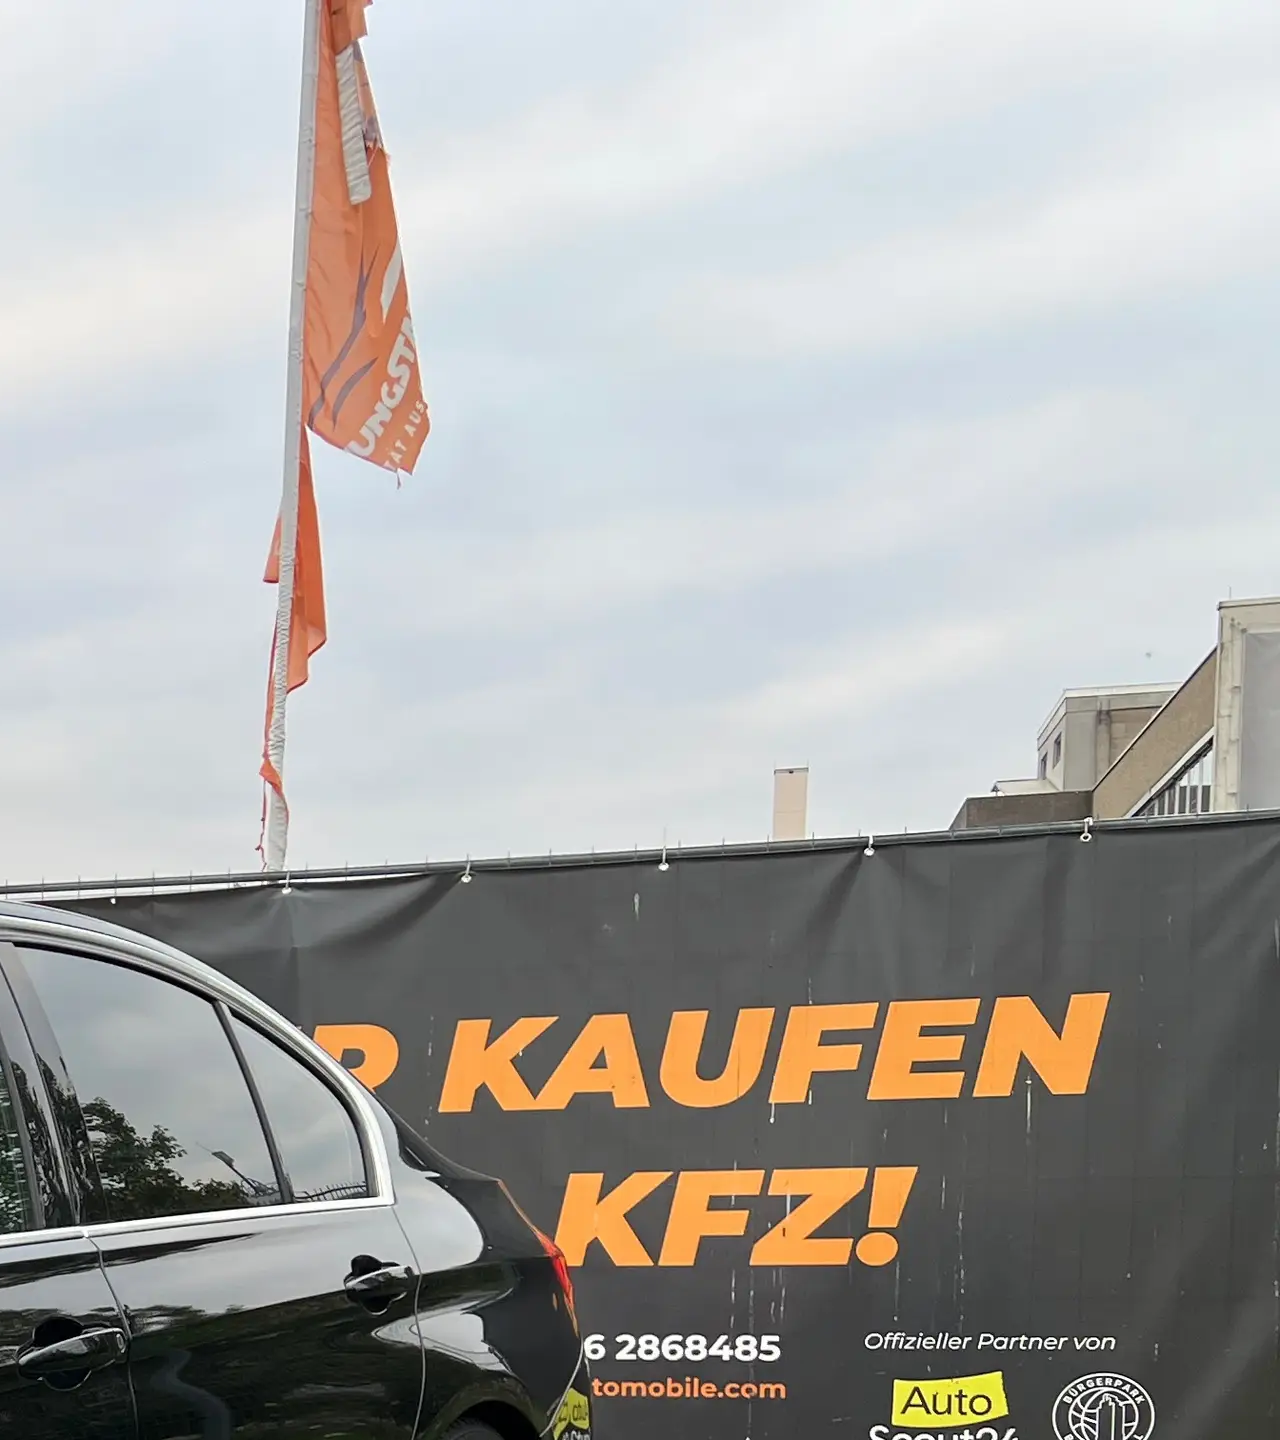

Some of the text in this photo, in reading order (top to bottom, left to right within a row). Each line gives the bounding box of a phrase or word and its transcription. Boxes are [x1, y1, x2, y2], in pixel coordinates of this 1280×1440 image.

[438, 992, 1111, 1113] KAUFEN
[554, 1166, 918, 1267] KFZ!
[615, 1333, 781, 1362] 2868485
[864, 1331, 1117, 1351] Offizieller Partner von
[900, 1386, 992, 1416] Auto
